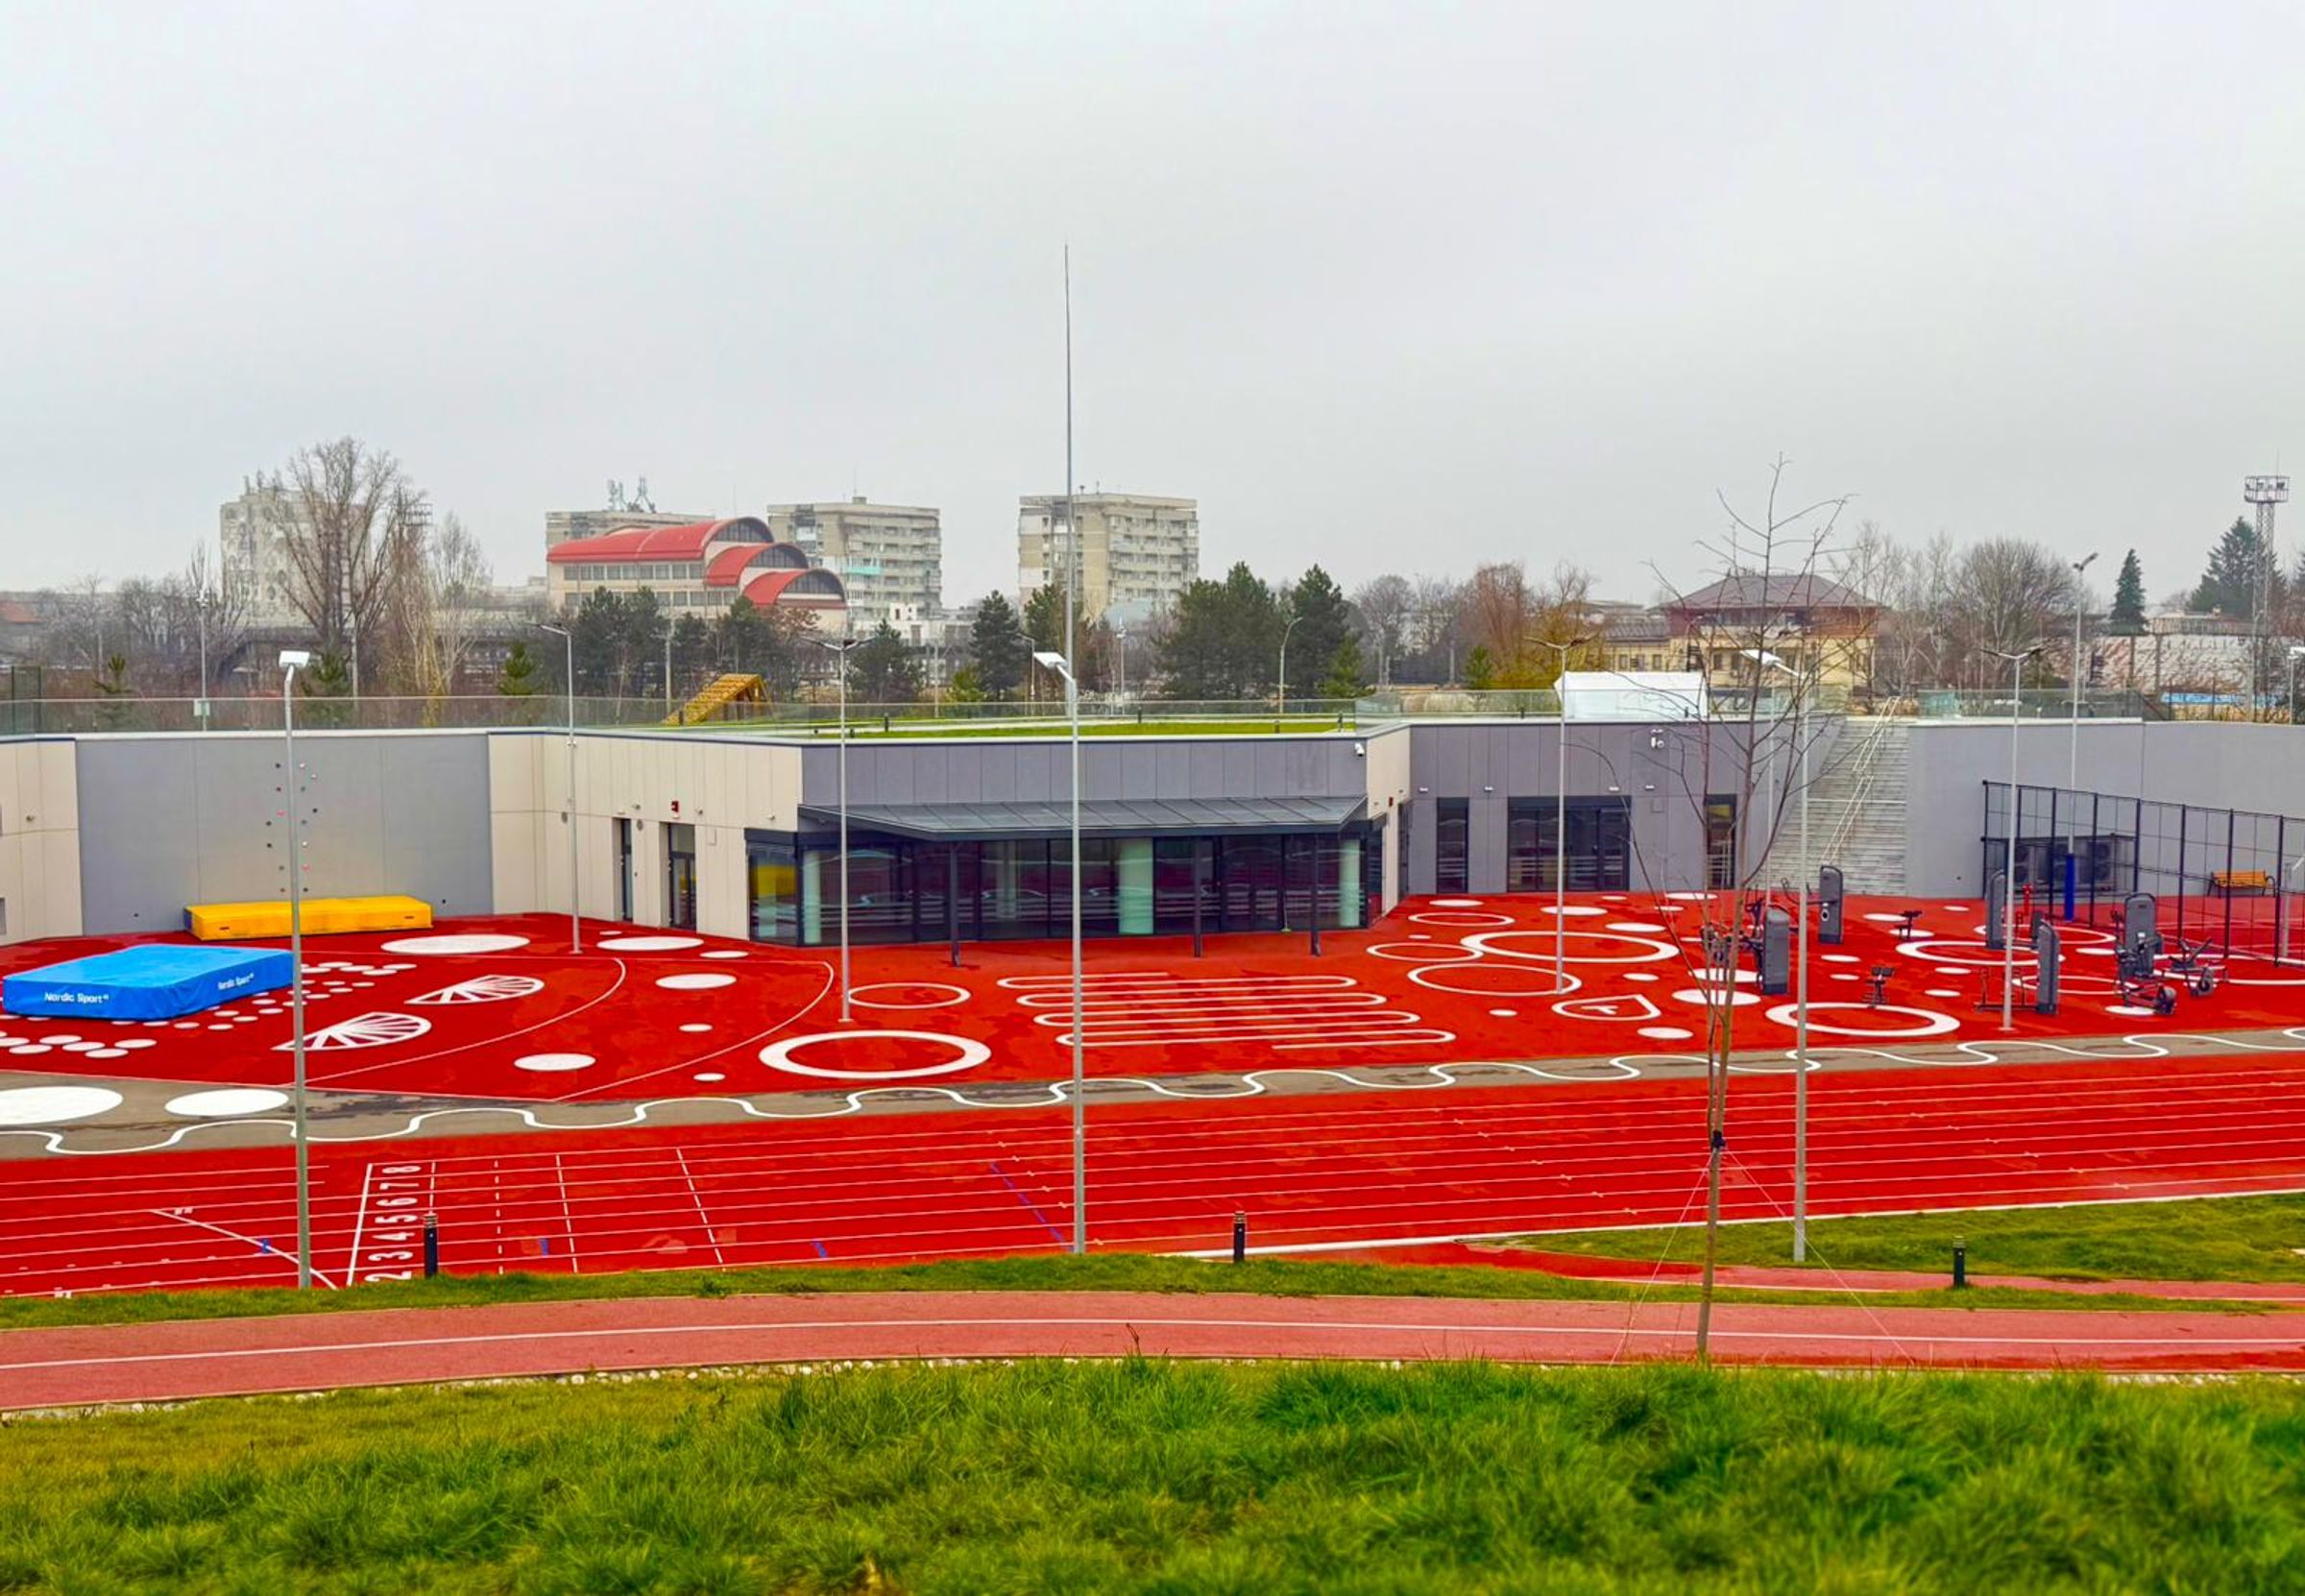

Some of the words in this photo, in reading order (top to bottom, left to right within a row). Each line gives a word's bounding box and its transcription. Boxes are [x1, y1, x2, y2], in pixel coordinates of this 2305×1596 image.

[44, 991, 75, 1003] Nordic
[77, 992, 104, 1004] Sport
[382, 1165, 422, 1173] 8
[376, 1197, 418, 1206] 6
[375, 1214, 418, 1223] 5
[372, 1232, 415, 1241] 4
[368, 1251, 413, 1261] 3
[365, 1270, 411, 1282] 2
